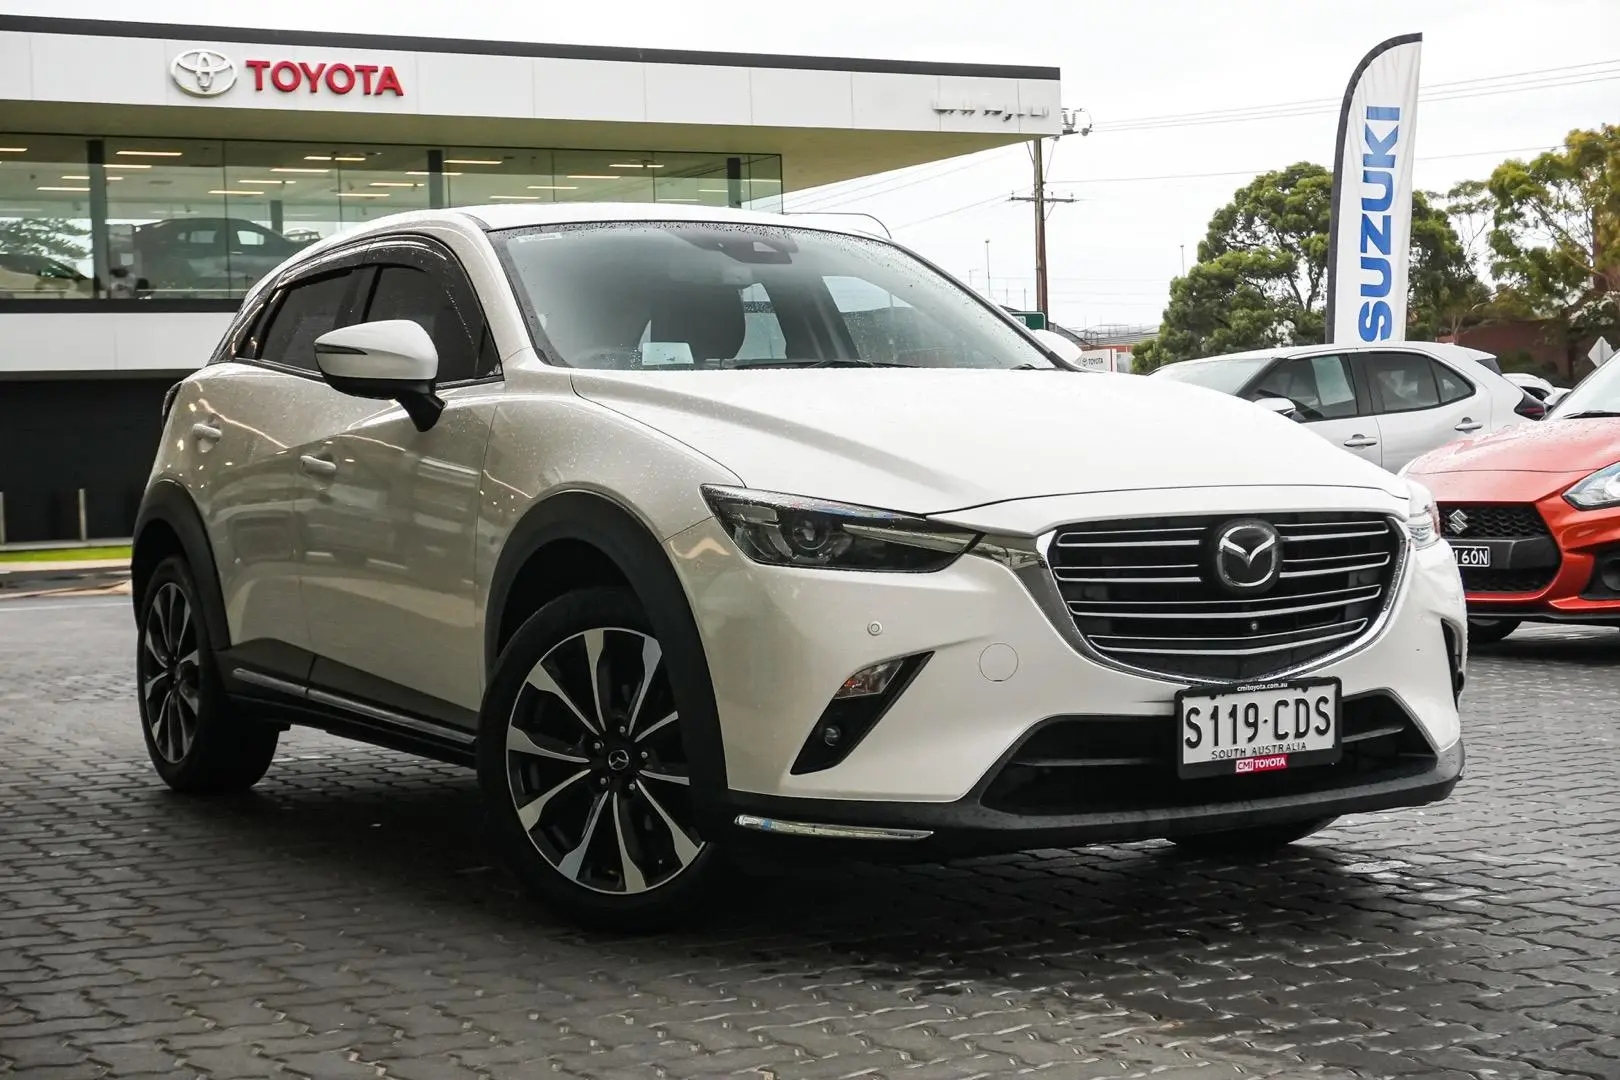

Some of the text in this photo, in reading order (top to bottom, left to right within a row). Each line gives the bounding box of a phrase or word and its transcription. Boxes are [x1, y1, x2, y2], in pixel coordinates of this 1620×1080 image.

[246, 60, 404, 96] TOYOTA
[1358, 106, 1400, 342] SUZUKI
[1237, 682, 1288, 692] cmitoyota.com.au
[1211, 742, 1307, 760] SOUTH AUSTRALIA
[1254, 757, 1286, 769] TOYOTA
